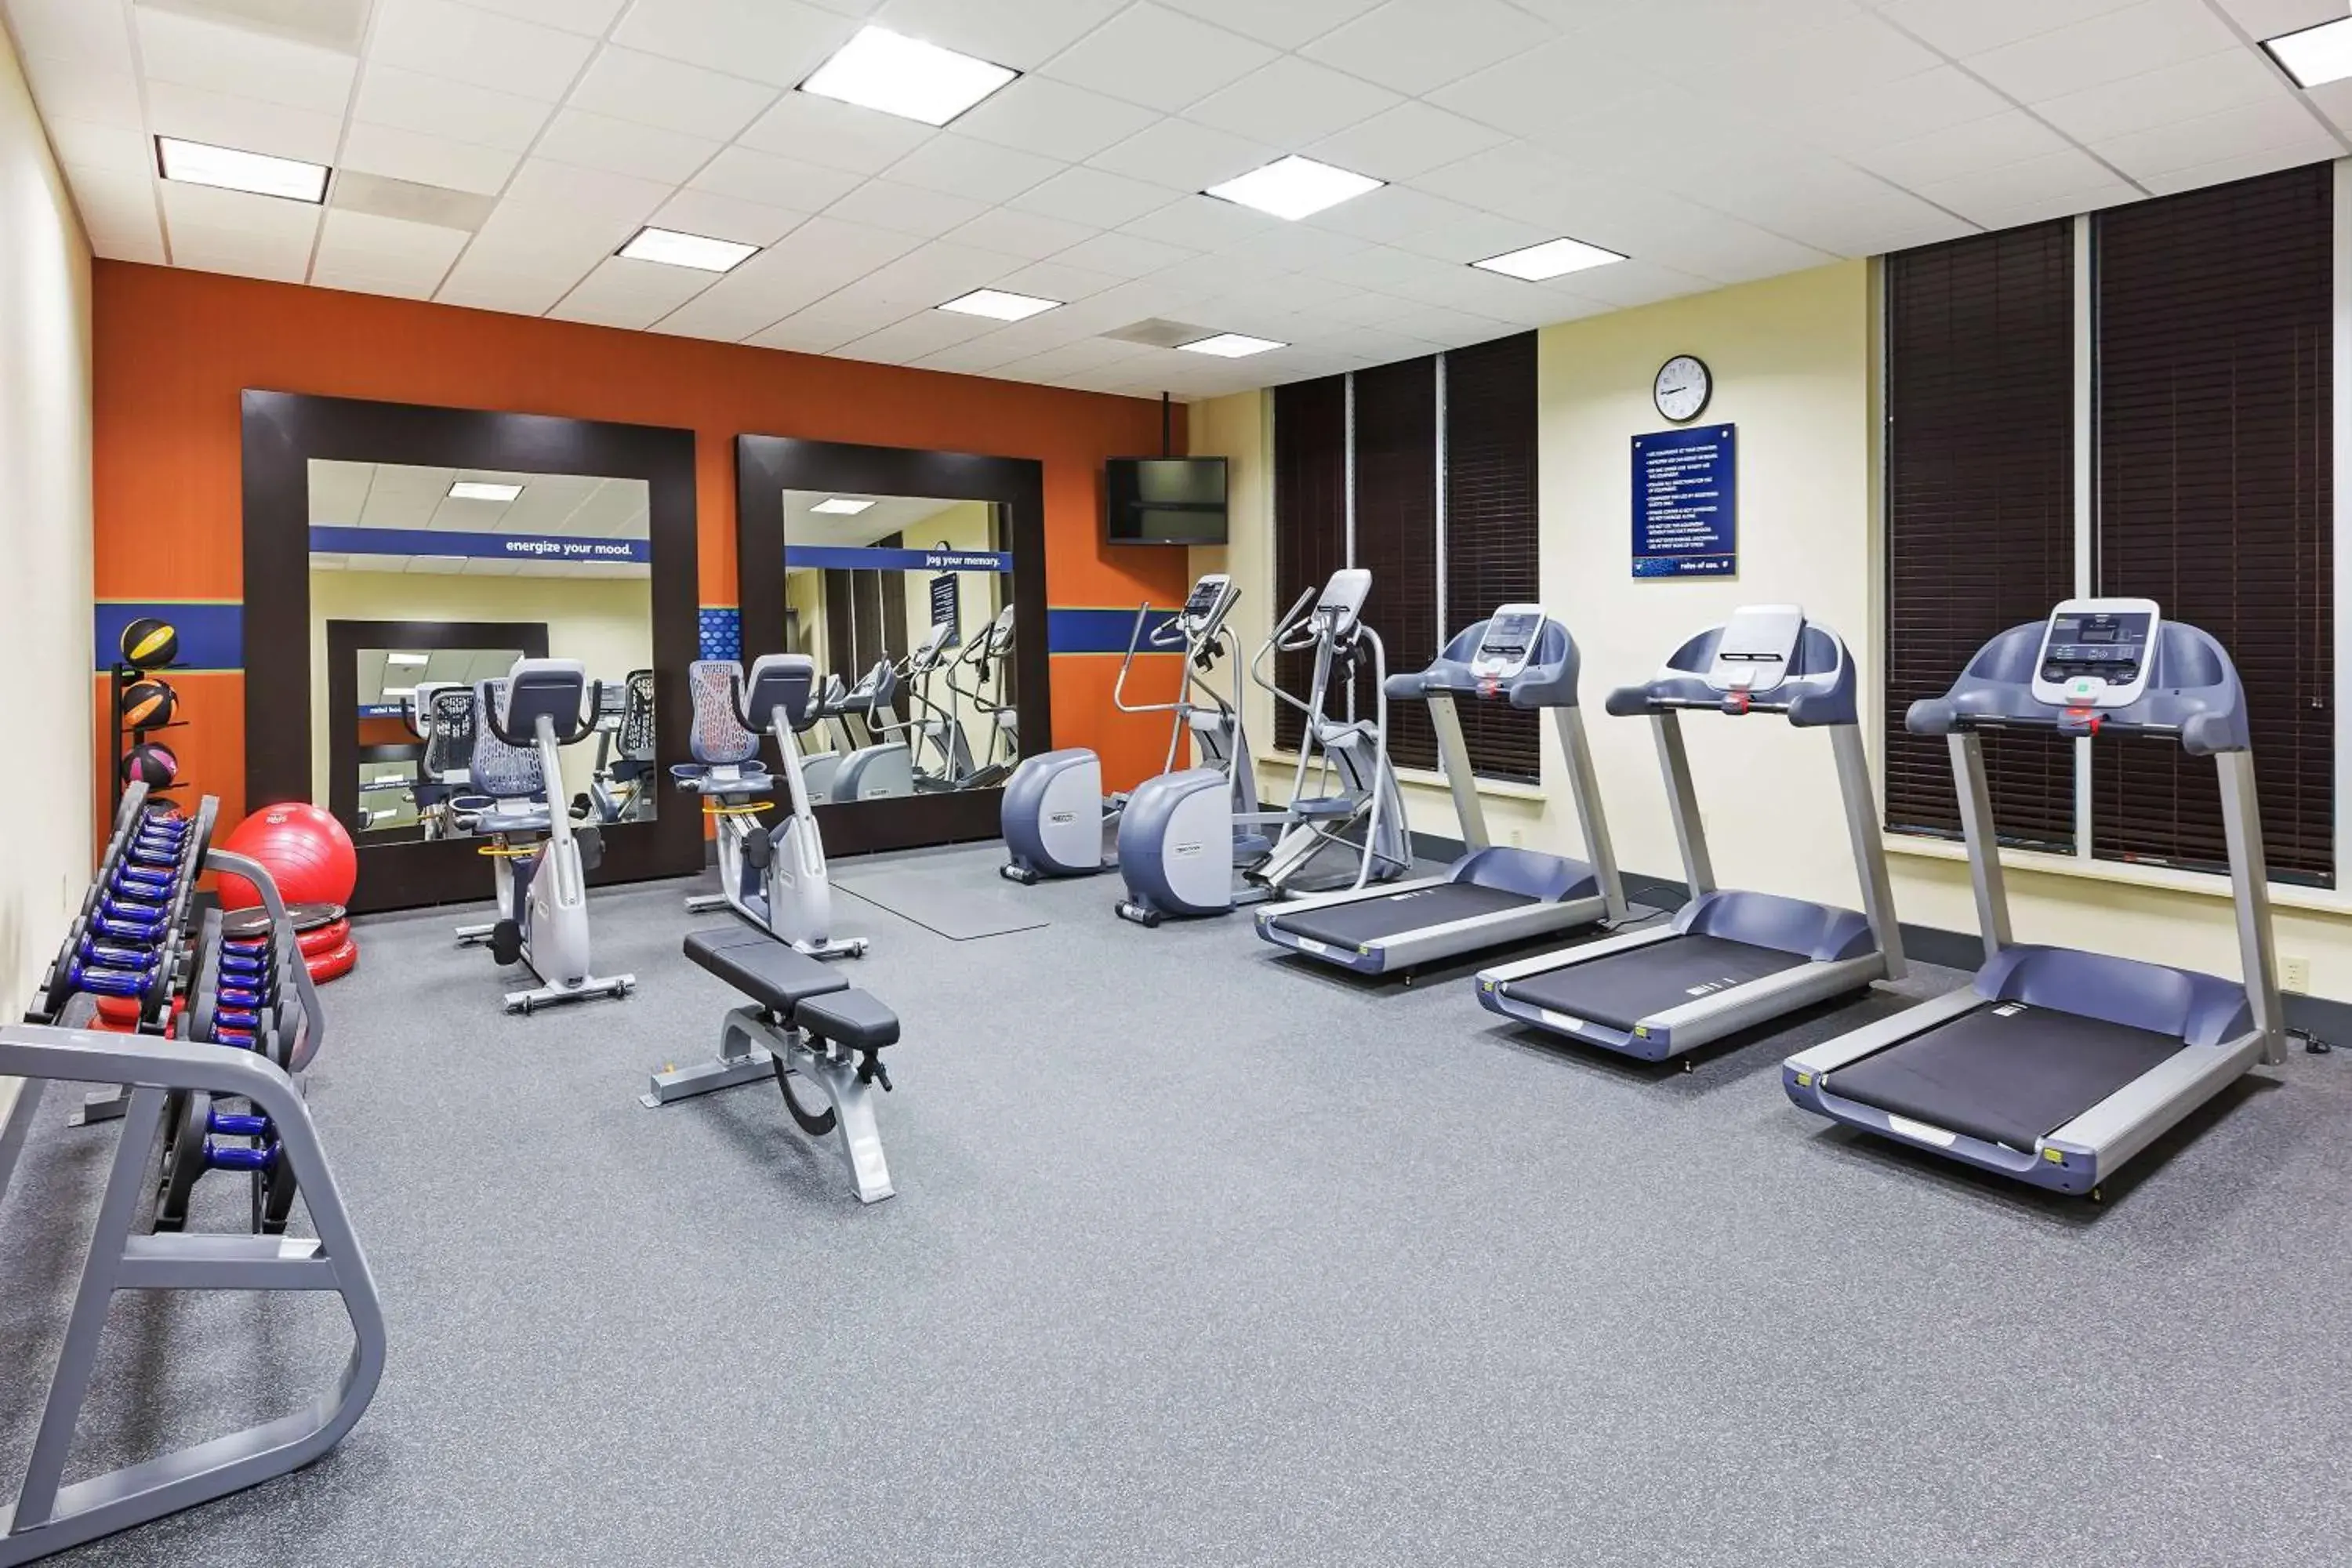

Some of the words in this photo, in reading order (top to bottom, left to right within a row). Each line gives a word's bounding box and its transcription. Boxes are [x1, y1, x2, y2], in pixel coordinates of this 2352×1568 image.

[506, 541, 561, 554] energize
[564, 543, 592, 556] your
[595, 543, 633, 555] mood.
[926, 554, 942, 566] jog
[942, 556, 963, 566] your
[964, 557, 1001, 568] memory.
